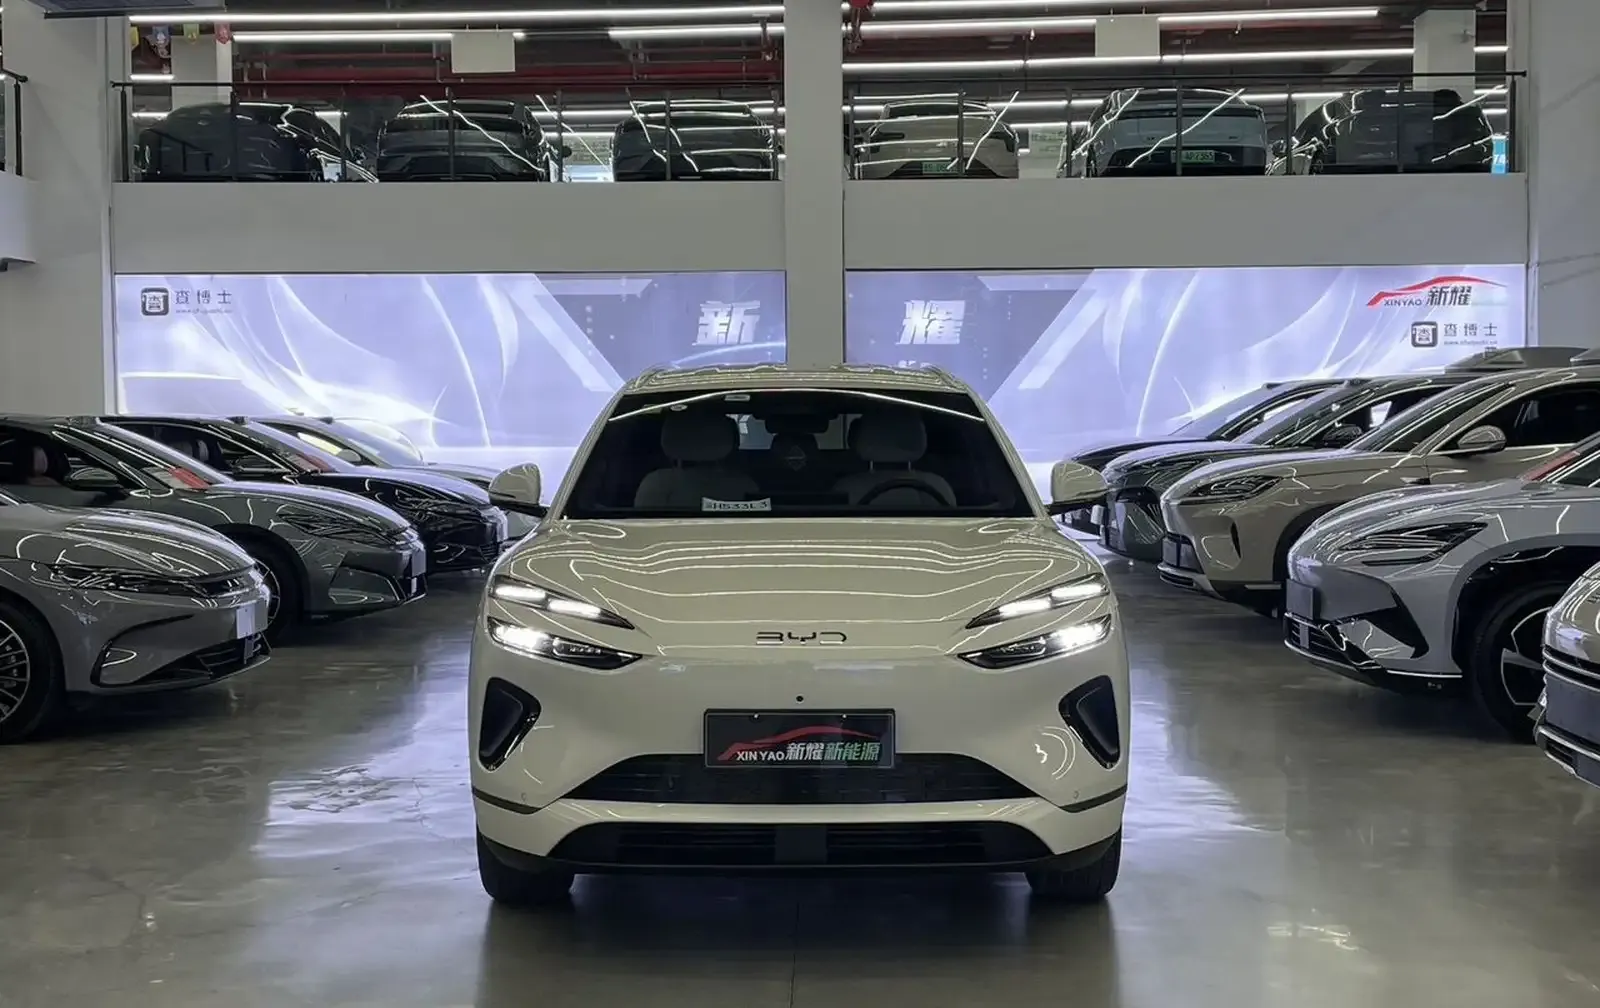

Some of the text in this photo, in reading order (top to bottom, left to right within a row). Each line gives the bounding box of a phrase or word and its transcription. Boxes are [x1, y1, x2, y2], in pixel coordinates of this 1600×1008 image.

[1427, 285, 1471, 305] 新耀
[693, 300, 965, 345] 新 耀
[757, 631, 847, 642] BYD
[737, 751, 785, 761] XIN YAO
